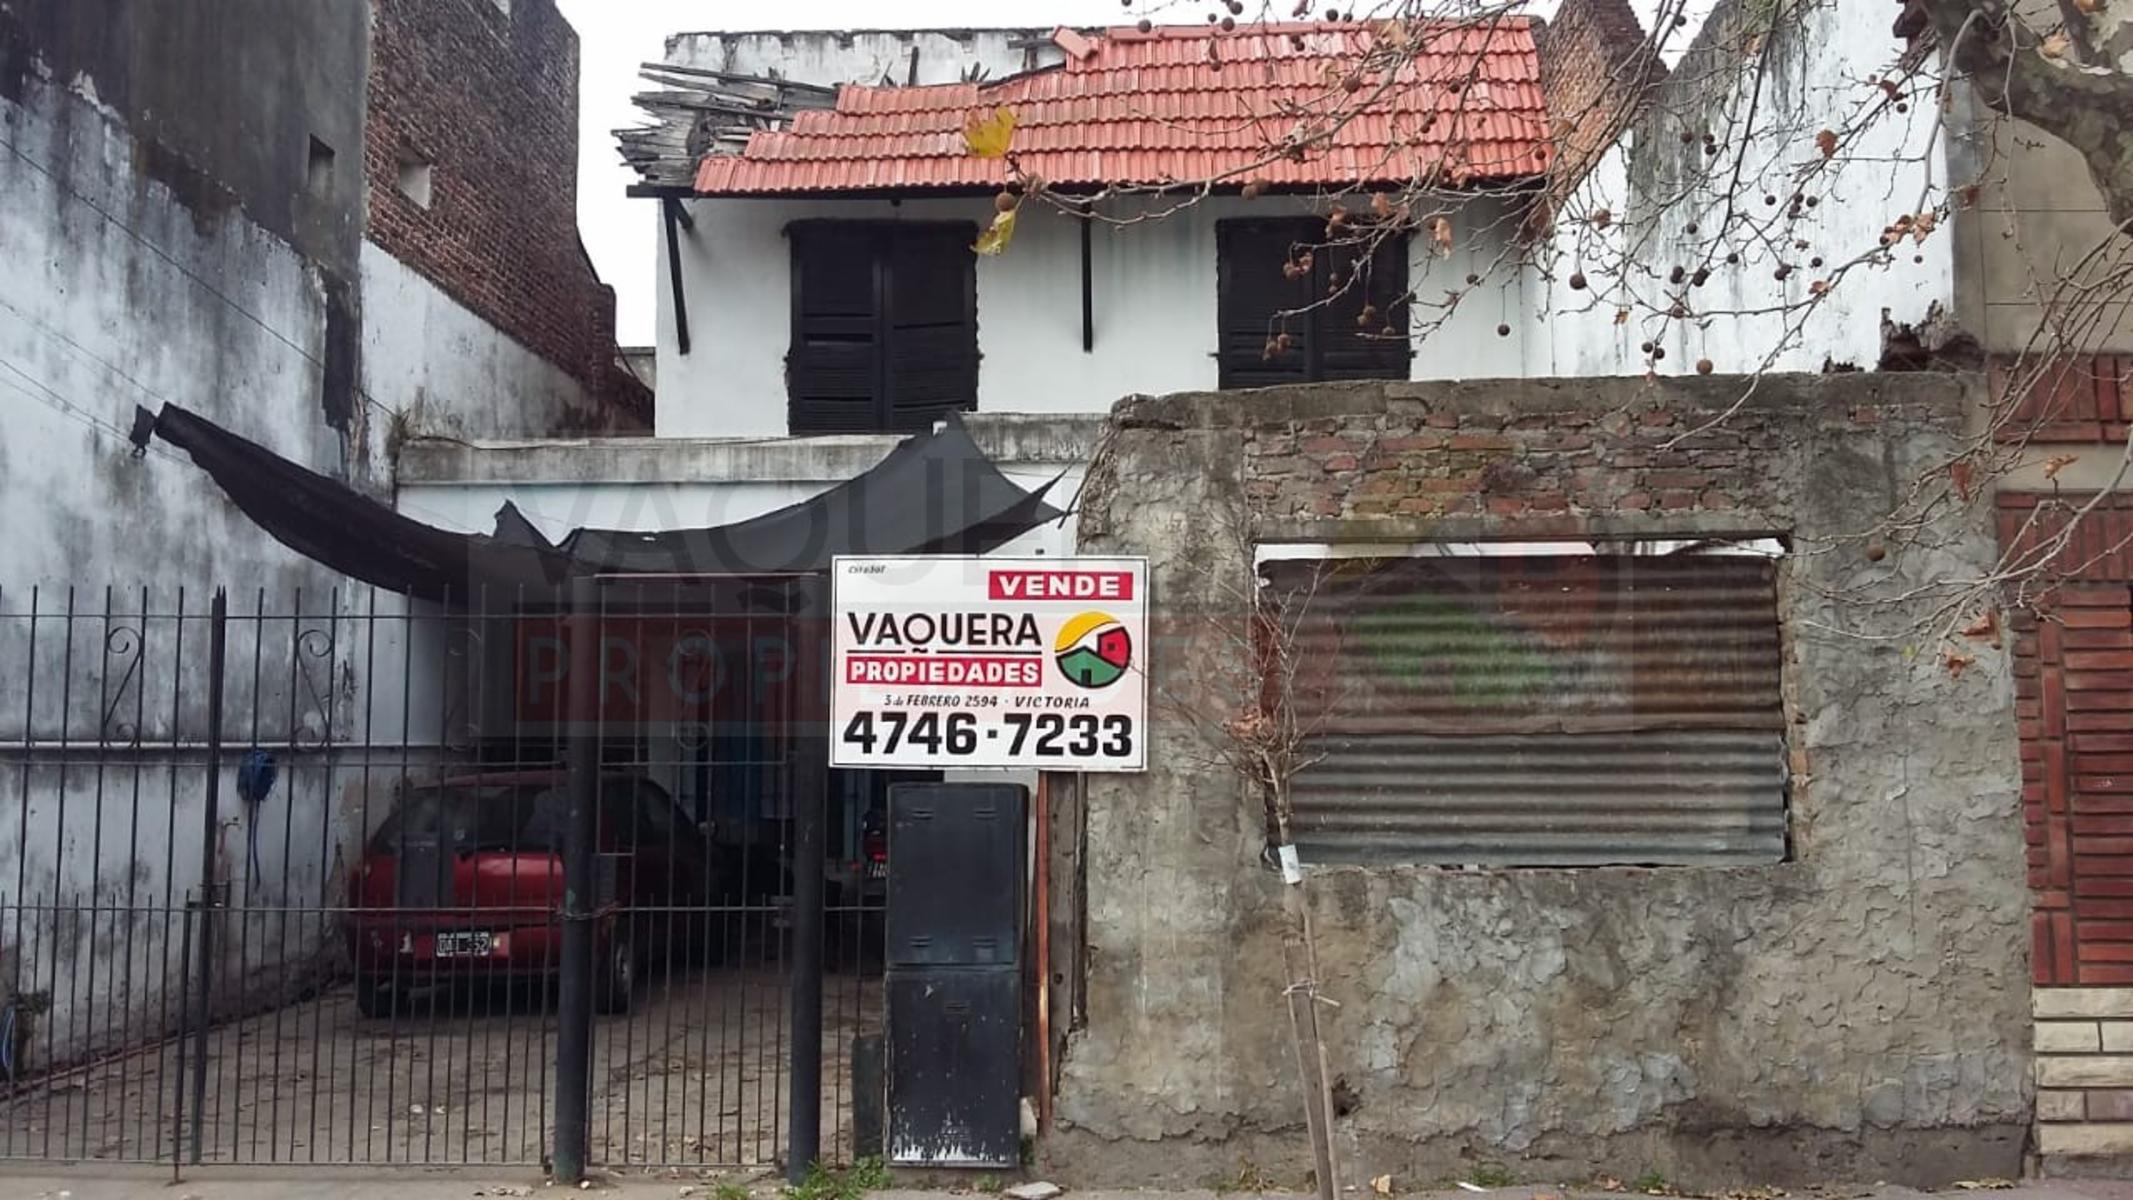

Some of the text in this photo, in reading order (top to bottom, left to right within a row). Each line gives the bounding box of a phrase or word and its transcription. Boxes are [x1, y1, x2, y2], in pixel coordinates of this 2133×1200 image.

[999, 575, 1121, 597] VENDE
[847, 612, 1043, 654] VAQUERA
[851, 660, 1040, 685] PROPIEDADES
[906, 694, 961, 707] FEBRERO
[965, 695, 998, 708] 2594
[1015, 696, 1090, 709] VICTORIA
